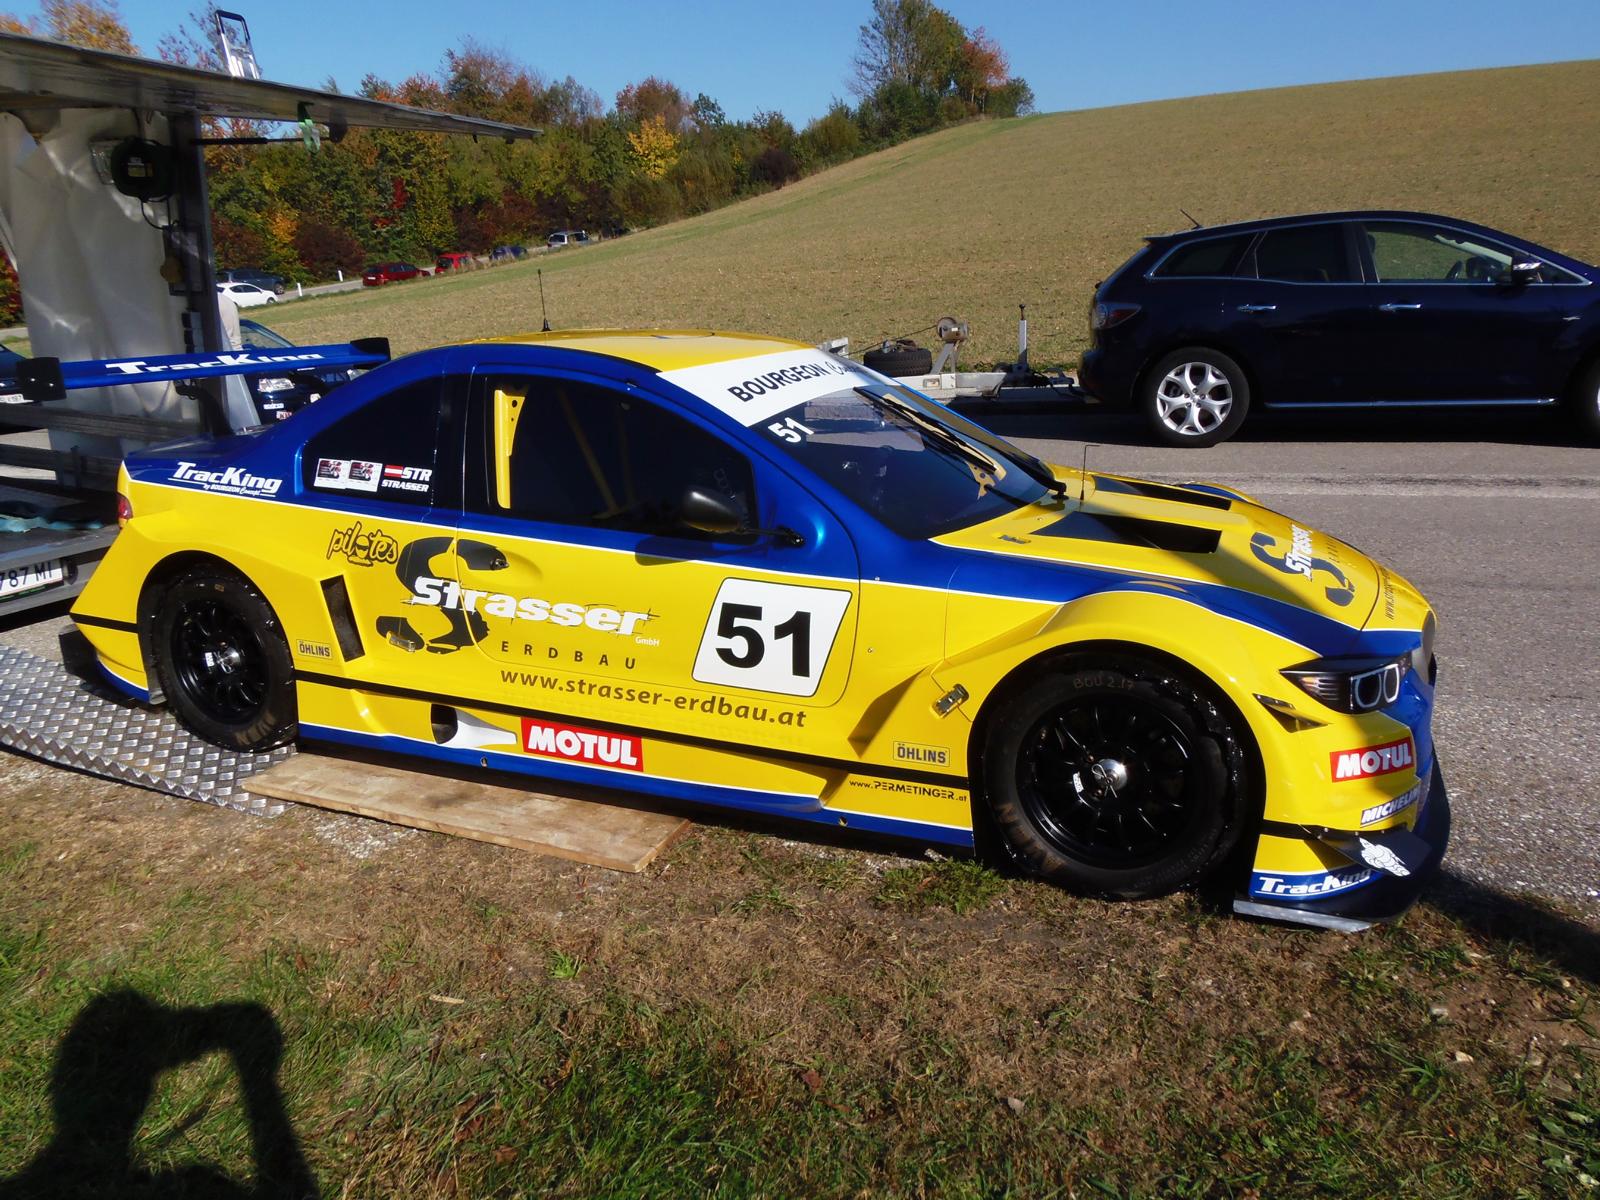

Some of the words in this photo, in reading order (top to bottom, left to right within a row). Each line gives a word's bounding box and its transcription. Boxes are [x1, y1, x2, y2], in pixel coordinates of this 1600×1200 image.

[727, 363, 831, 402] BOURGEON
[767, 417, 814, 443] 51
[173, 461, 282, 494] TracKing
[381, 480, 429, 493] STRASSER
[402, 467, 432, 481] STR
[411, 575, 650, 635] Strasser
[299, 640, 331, 657] ÖHLINS
[635, 636, 660, 647] GmbH
[715, 602, 811, 678] 51
[500, 670, 807, 728] www.strasser-erdbau.at
[527, 725, 638, 766] MOTUL
[897, 743, 947, 764] ÖHLINS
[1336, 743, 1412, 779] MOTUL
[849, 780, 967, 802] www.PERMETINGER.at
[1361, 785, 1420, 824] MICHELIN
